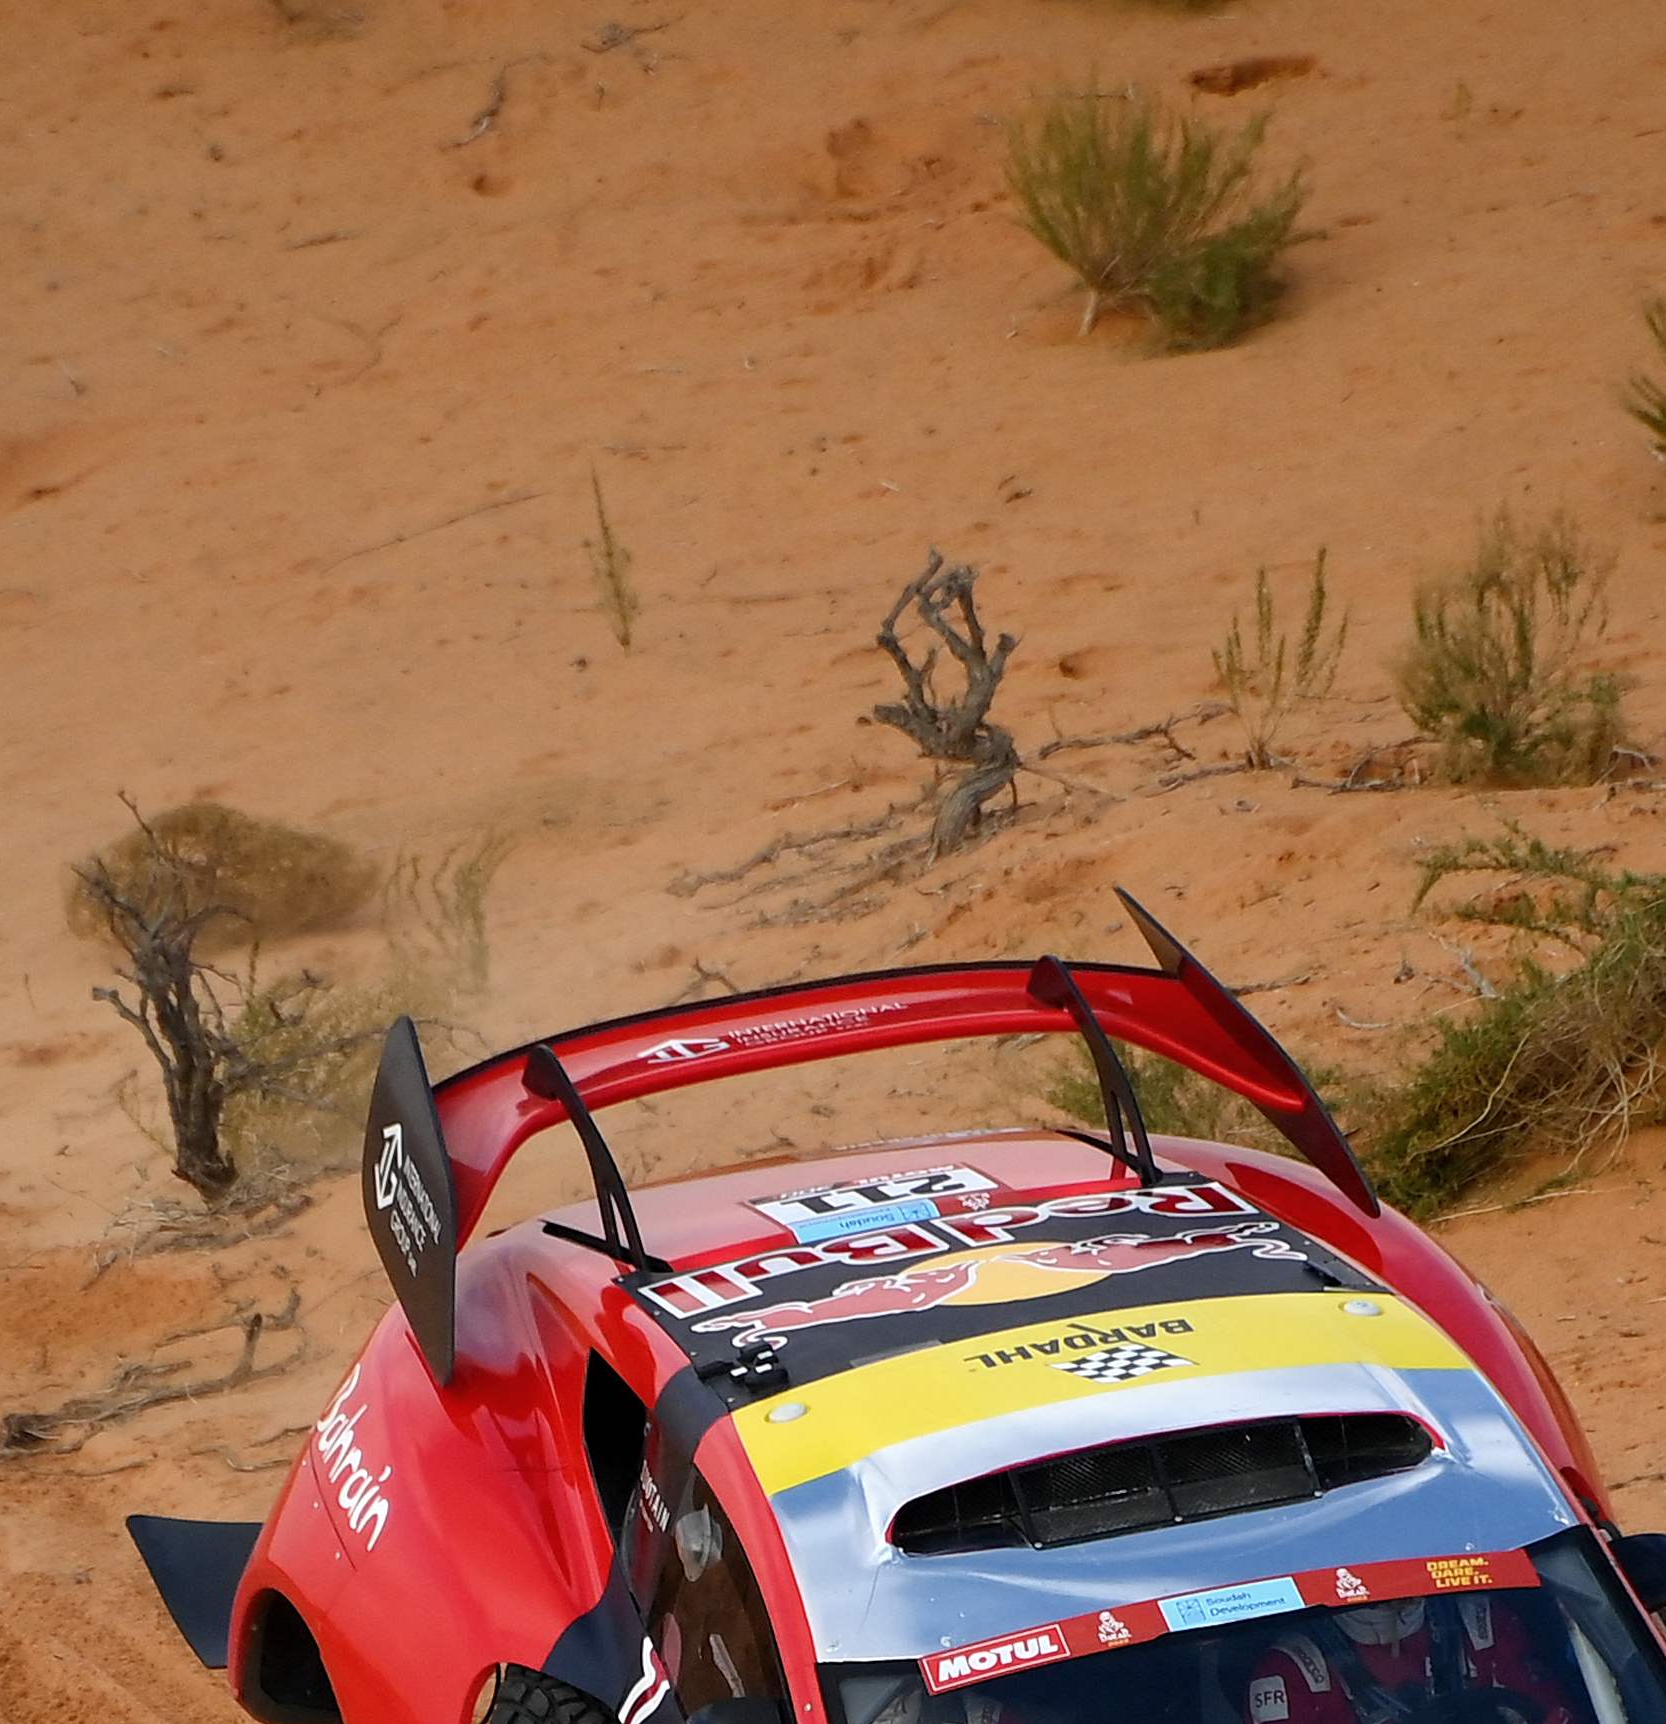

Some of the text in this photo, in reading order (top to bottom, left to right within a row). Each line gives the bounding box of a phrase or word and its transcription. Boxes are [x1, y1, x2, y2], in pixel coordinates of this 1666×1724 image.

[779, 1172, 967, 1215] 211
[637, 1181, 1263, 1318] Red Bull
[963, 1318, 1195, 1369] BARDAHL
[317, 1362, 392, 1552] Bahrain
[1426, 1557, 1490, 1572] DREAM.
[1431, 1566, 1480, 1579] DARE.
[1435, 1574, 1493, 1588] LIVE IT.
[1209, 1597, 1286, 1618] Development
[938, 1634, 1060, 1683] MOTUL
[1254, 1689, 1286, 1708] SFR
